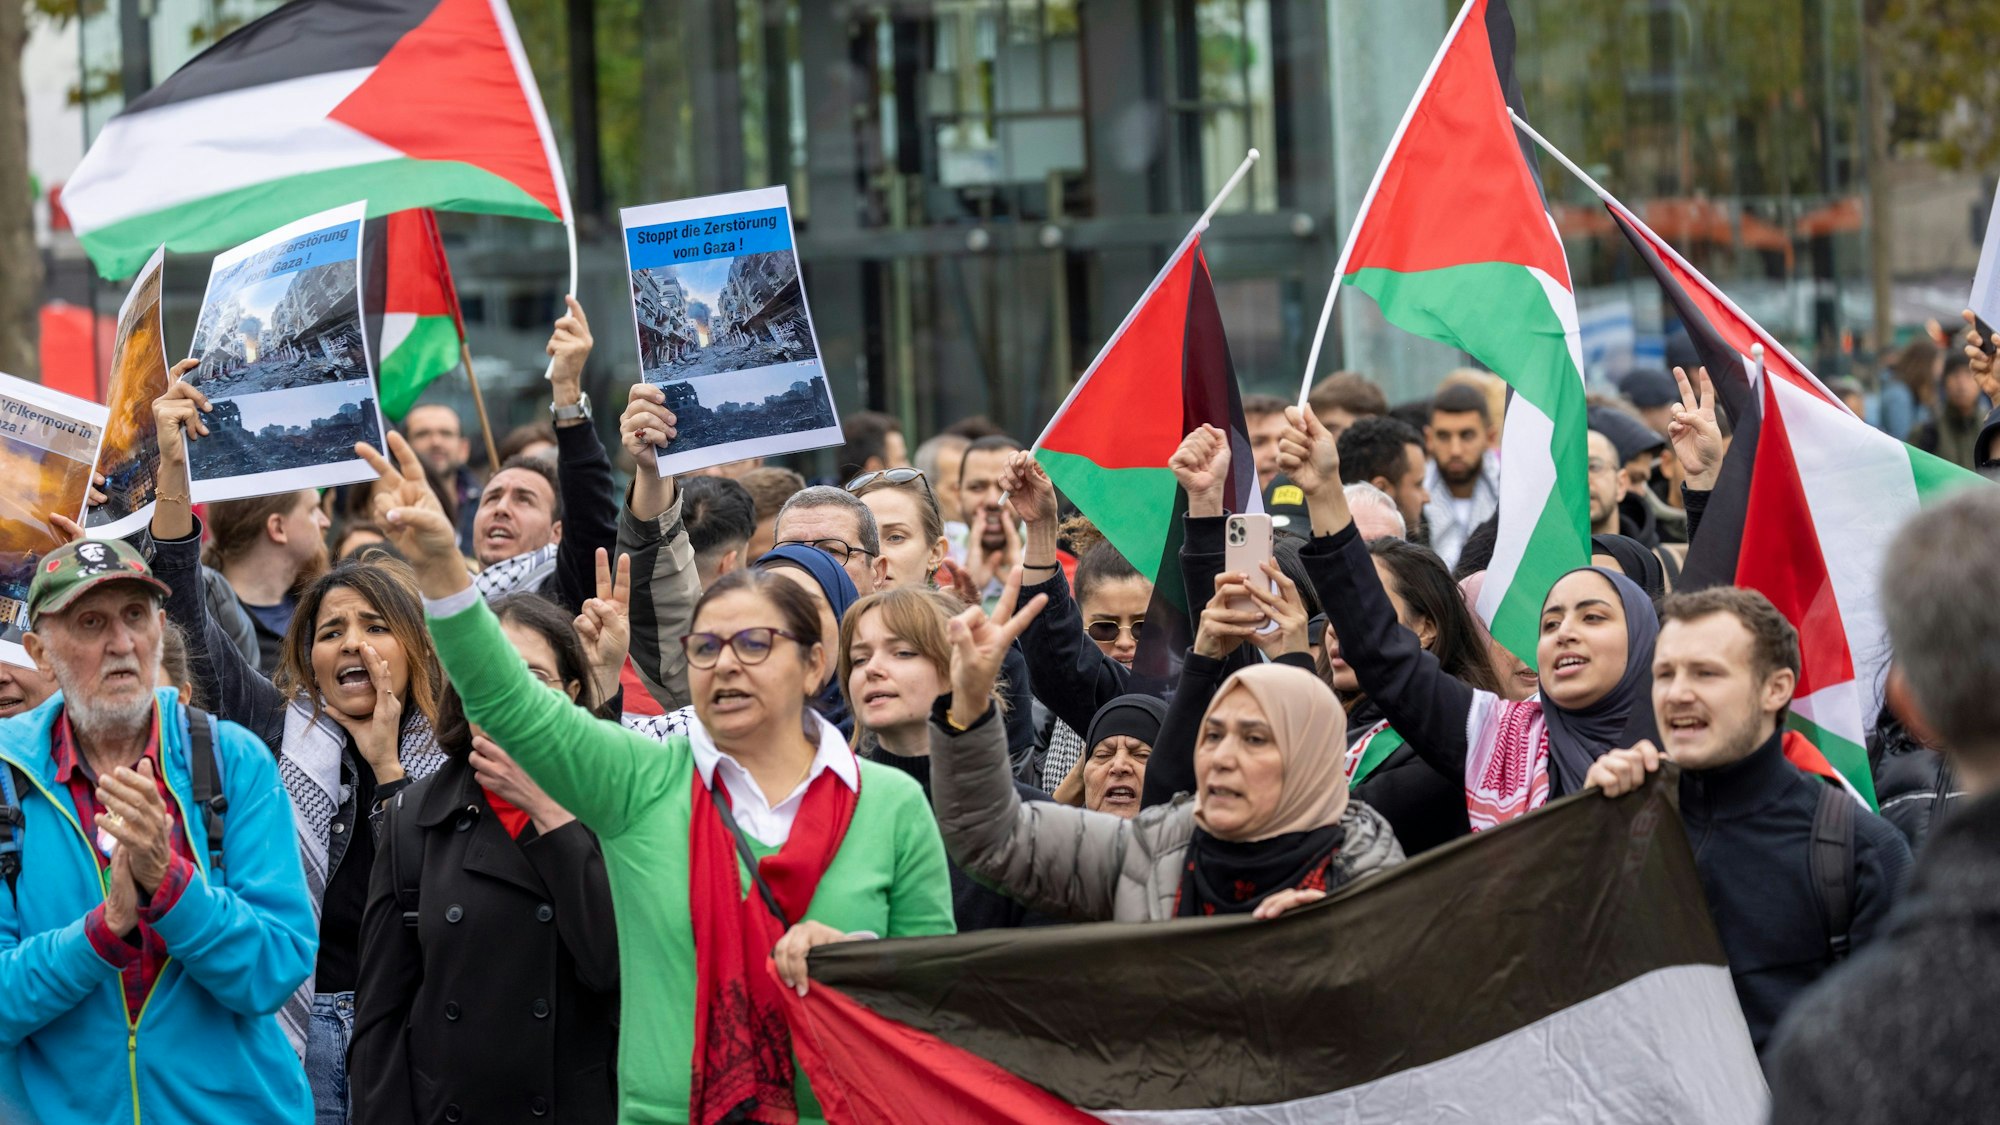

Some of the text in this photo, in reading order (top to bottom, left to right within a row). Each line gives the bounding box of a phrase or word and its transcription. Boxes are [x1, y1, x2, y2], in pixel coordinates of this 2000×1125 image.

[637, 214, 777, 245] Stoppt die Zerstörung
[258, 249, 276, 265] die
[277, 227, 350, 257] Zerstörung
[673, 237, 744, 259] vom Gaza !
[244, 251, 313, 285] vom Gaza !
[2, 399, 92, 439] Völkermord in
[19, 424, 27, 435] !
